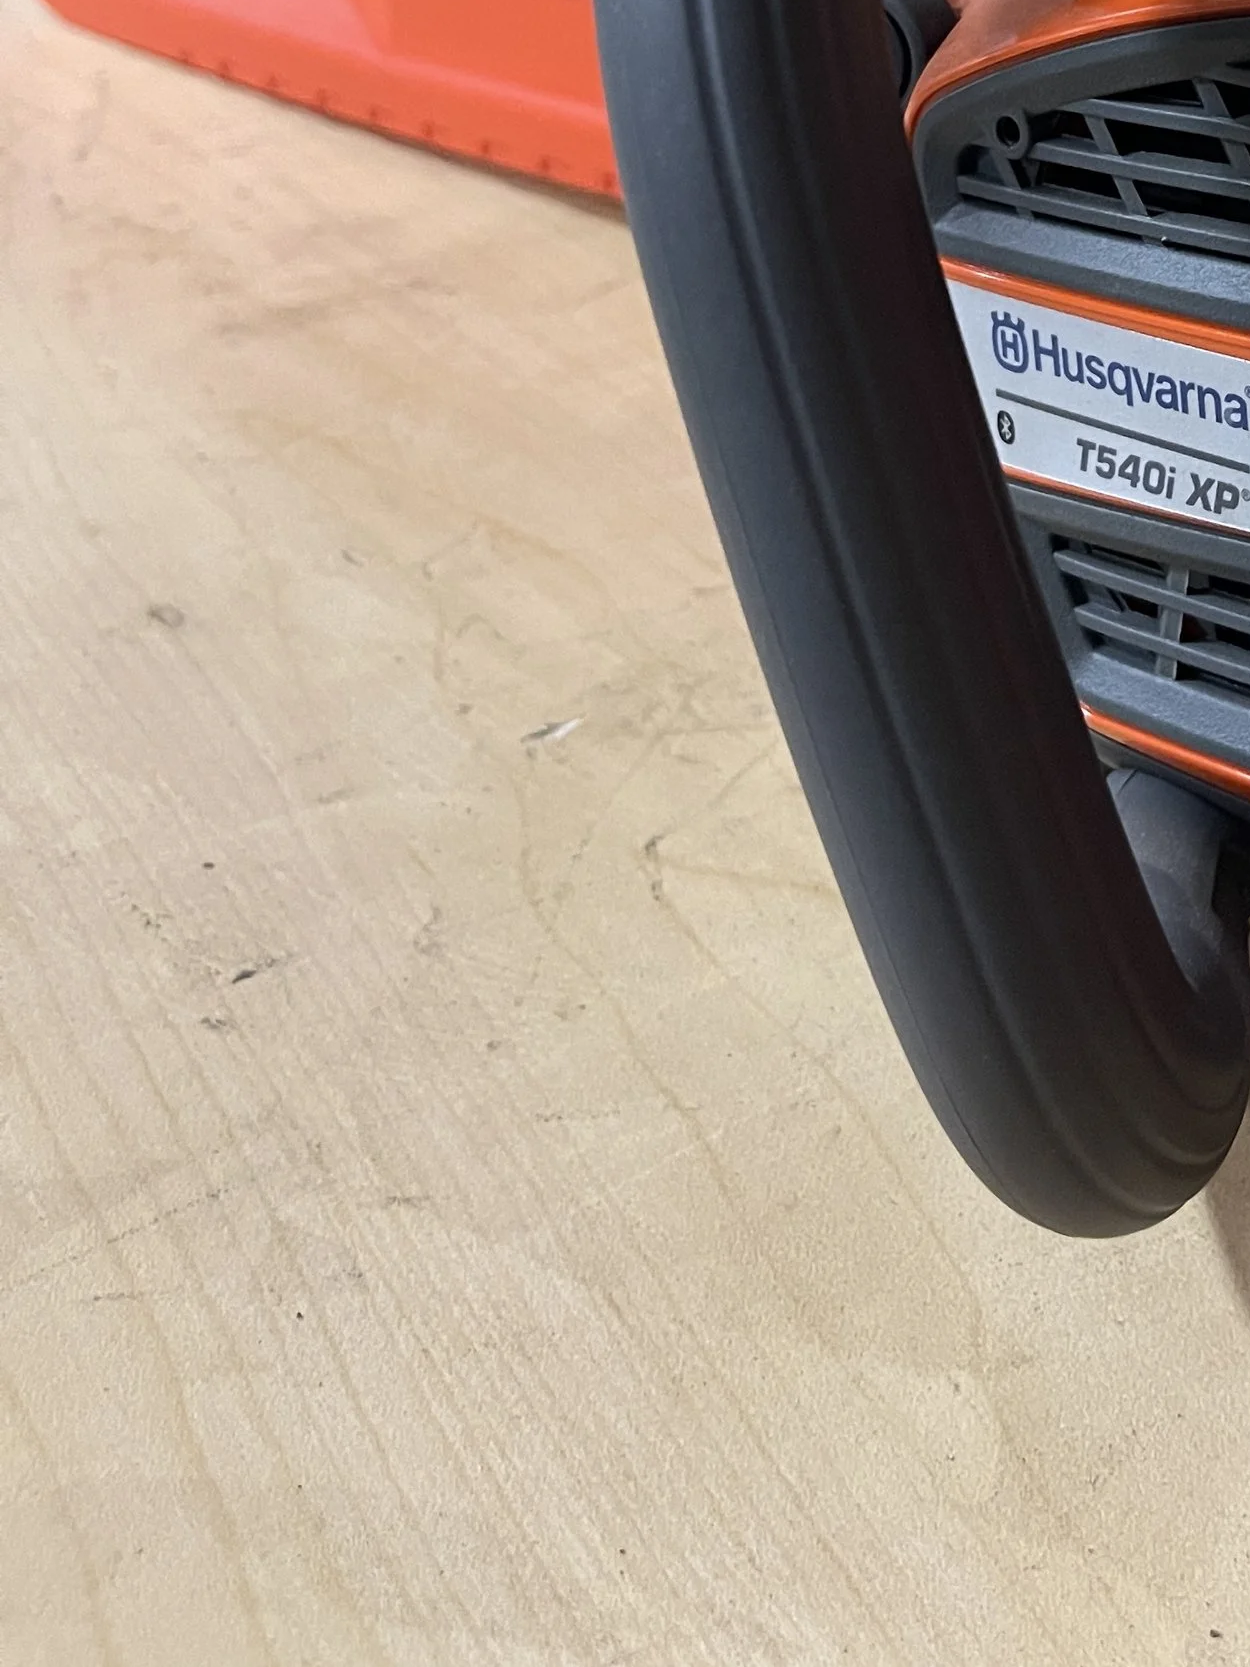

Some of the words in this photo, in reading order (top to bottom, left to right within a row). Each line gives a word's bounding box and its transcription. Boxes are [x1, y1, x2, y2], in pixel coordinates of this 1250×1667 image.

[1032, 329, 1249, 431] Husqvarna
[1076, 437, 1177, 499] T540i
[1185, 472, 1240, 514] XP
